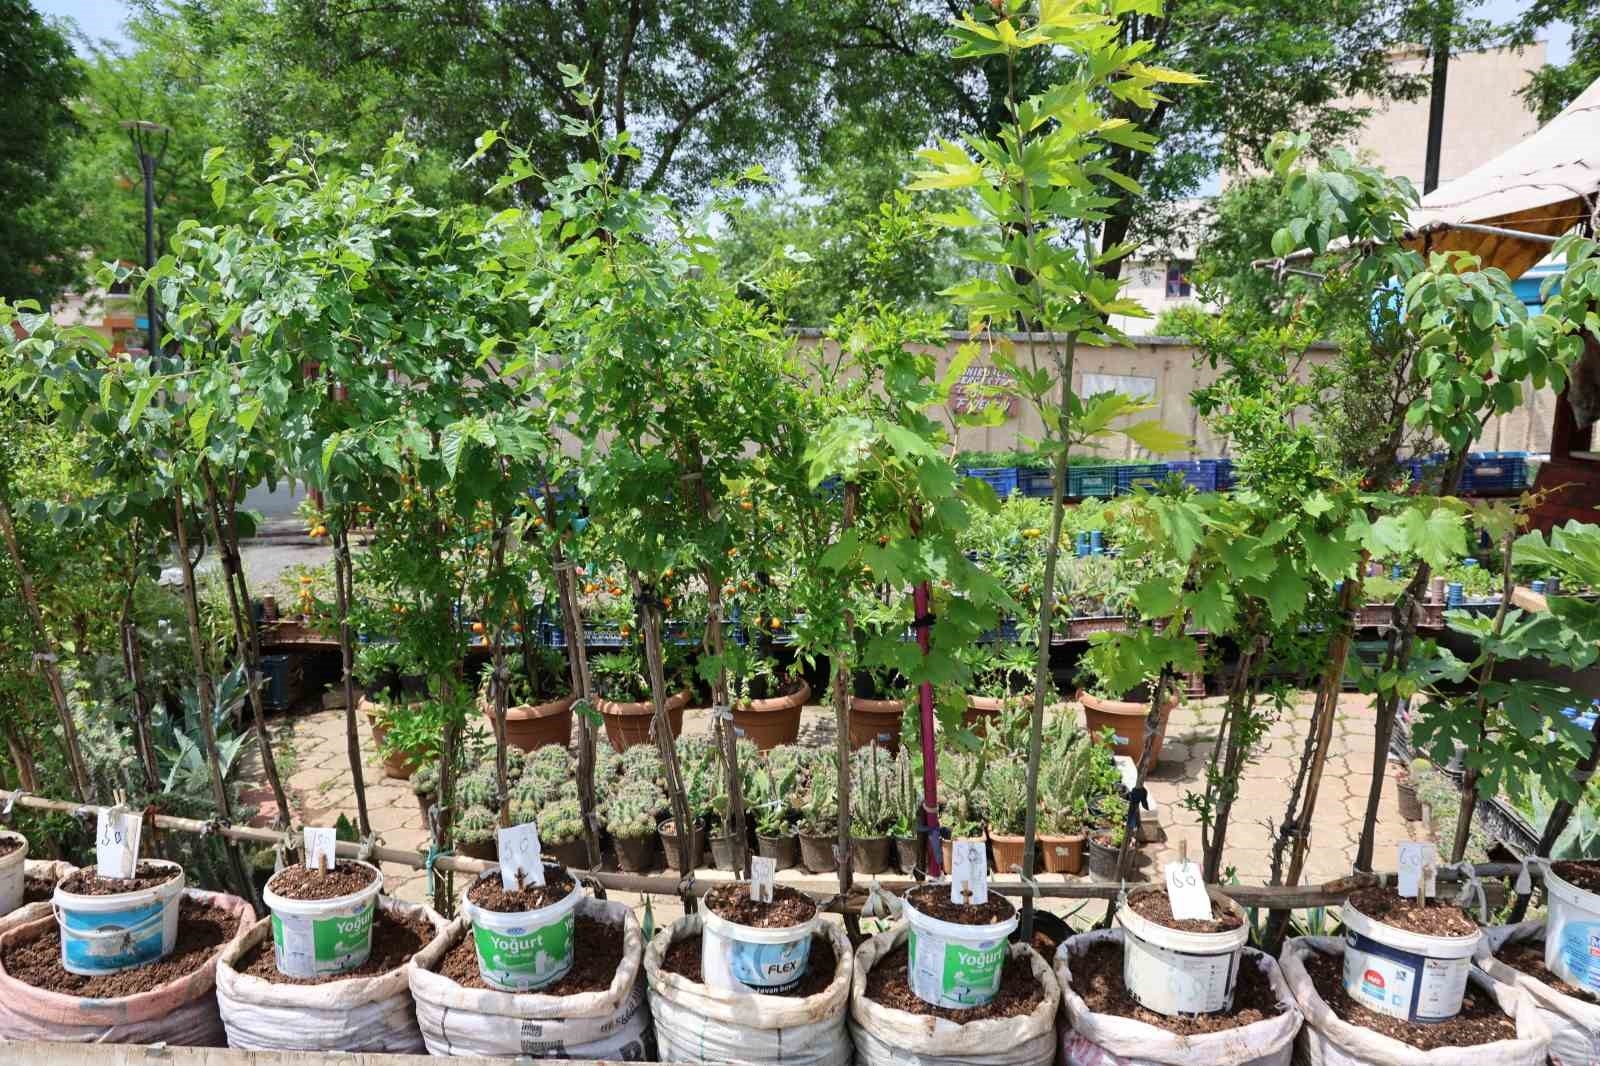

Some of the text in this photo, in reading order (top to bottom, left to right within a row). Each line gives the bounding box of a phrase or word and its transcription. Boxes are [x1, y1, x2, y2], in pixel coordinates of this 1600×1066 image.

[337, 911, 371, 934] Yoğur
[490, 934, 543, 953] Yoğurt
[768, 961, 796, 975] FLEX
